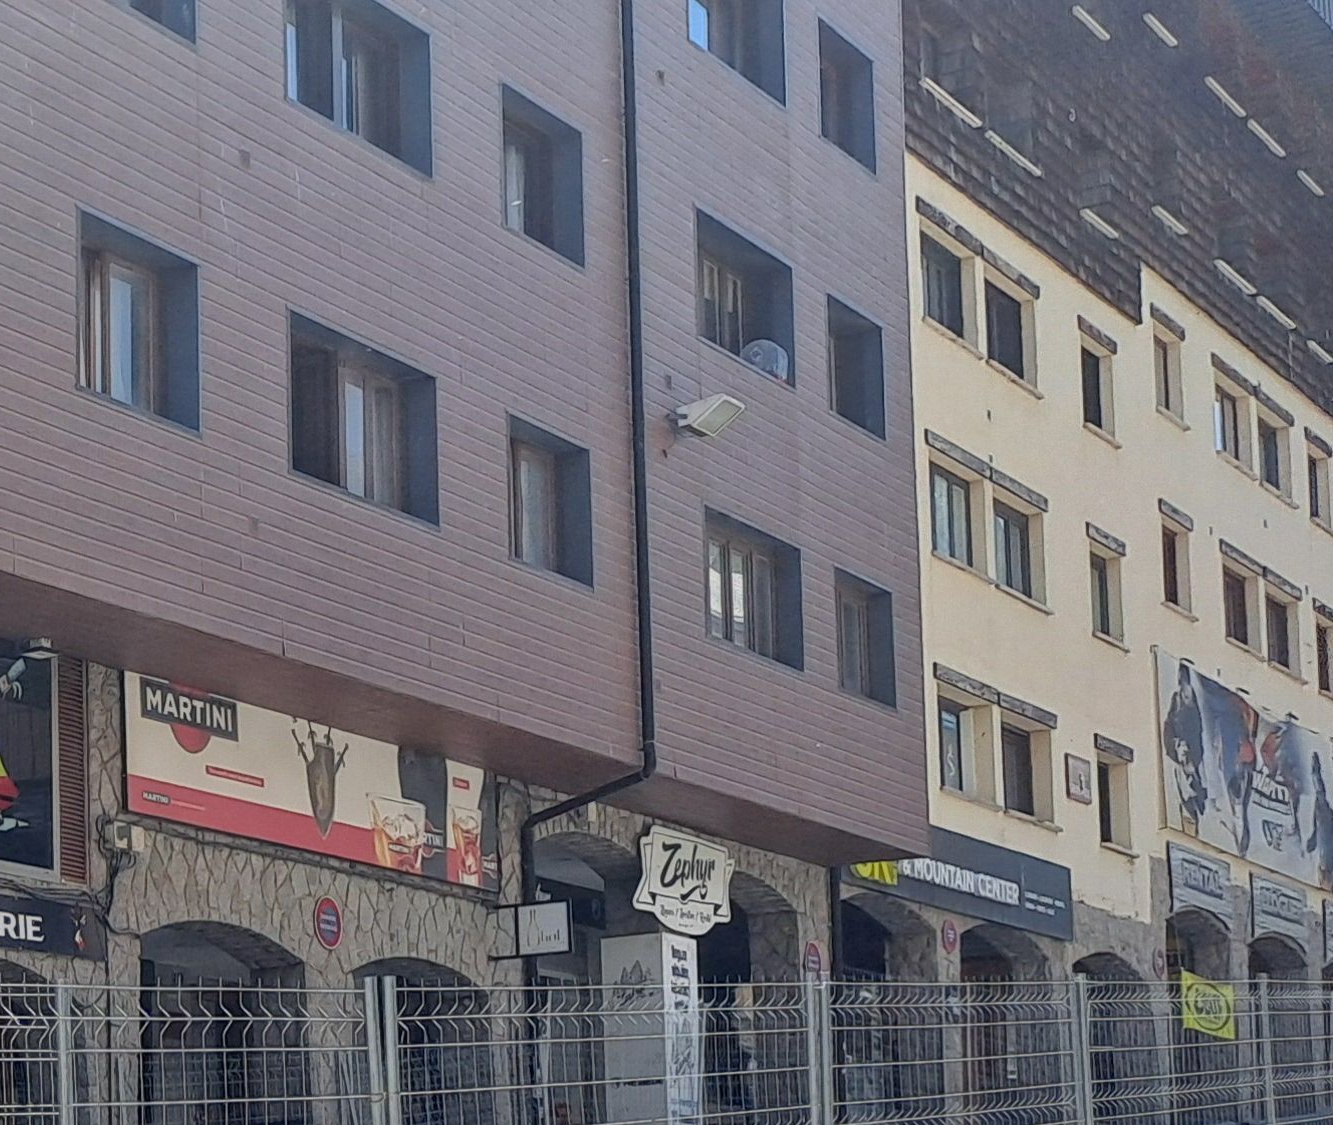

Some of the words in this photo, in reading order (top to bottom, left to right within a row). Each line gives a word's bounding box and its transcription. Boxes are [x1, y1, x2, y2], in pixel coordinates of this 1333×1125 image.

[145, 686, 233, 732] MARTINI
[660, 840, 716, 901] Zephyr
[915, 857, 975, 896] MOUNTAIN
[976, 872, 1021, 905] CENTER
